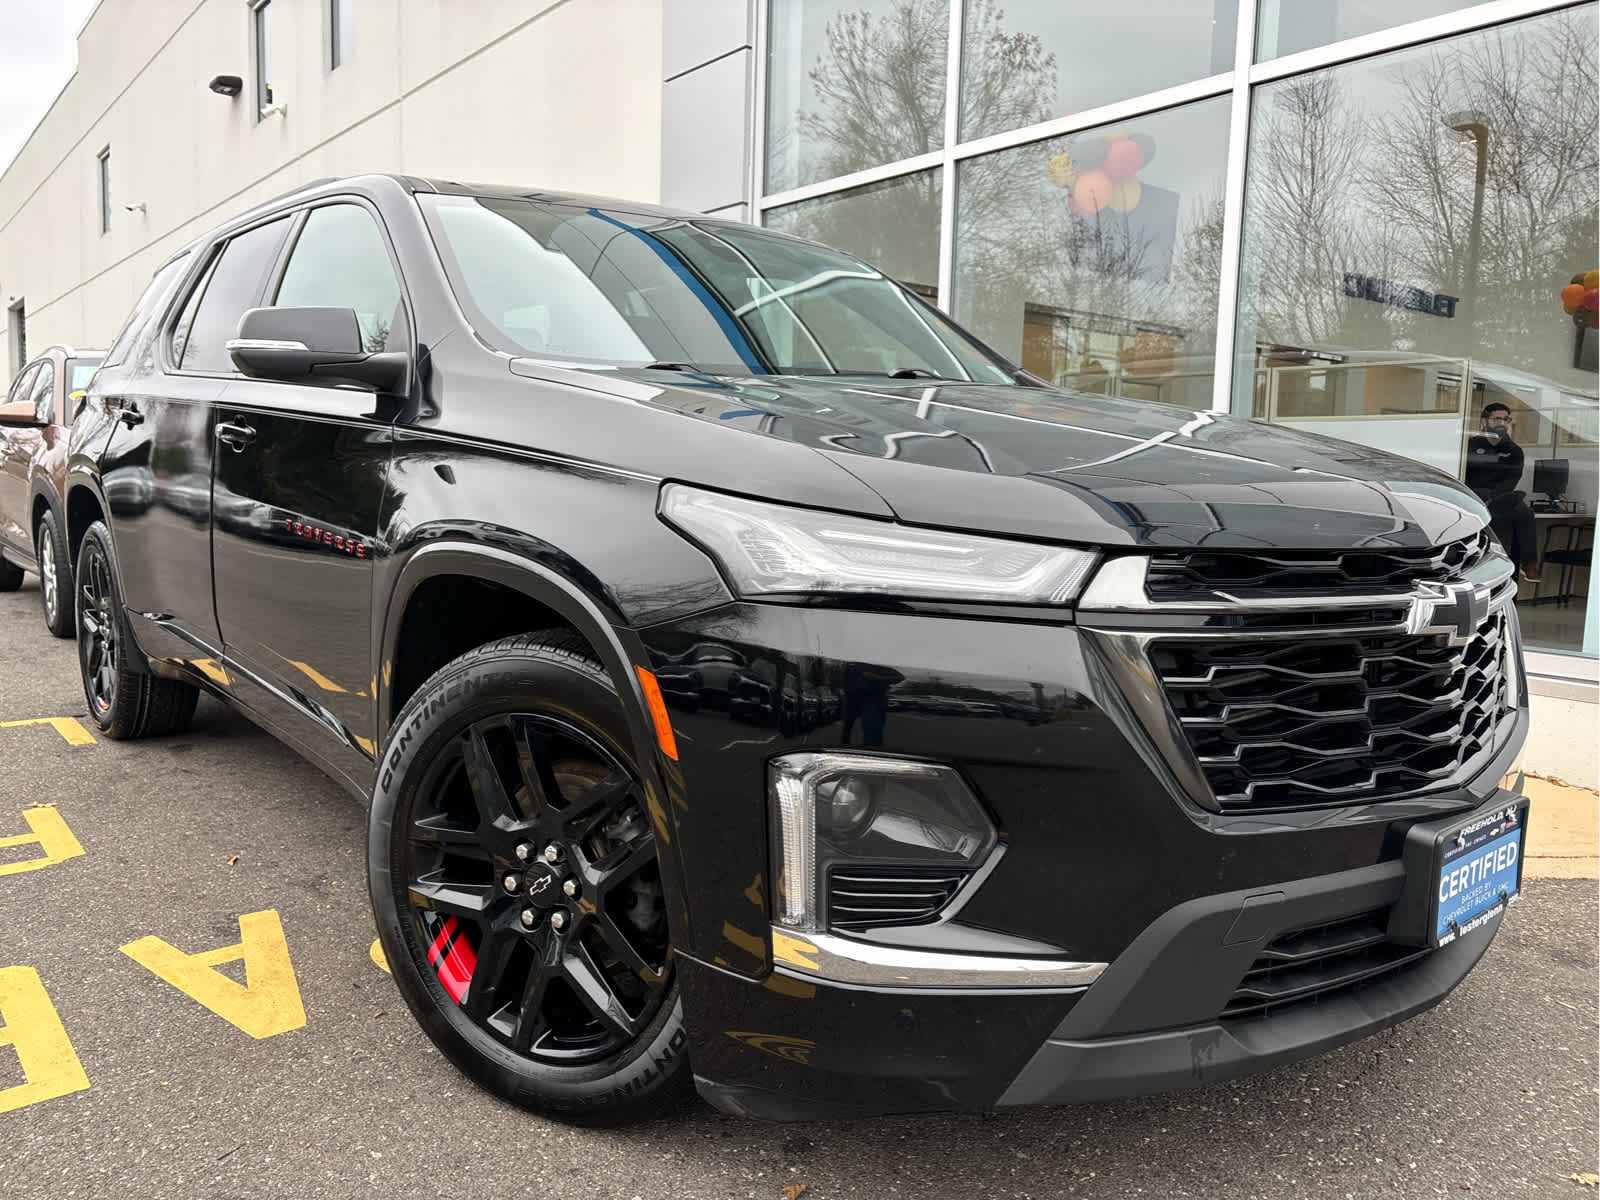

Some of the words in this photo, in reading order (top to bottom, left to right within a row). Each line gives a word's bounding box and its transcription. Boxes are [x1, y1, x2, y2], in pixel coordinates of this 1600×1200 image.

[1438, 841, 1517, 903] CERTIFIED
[1461, 885, 1483, 904] BACKED
[1459, 903, 1503, 937] lesterglenn
